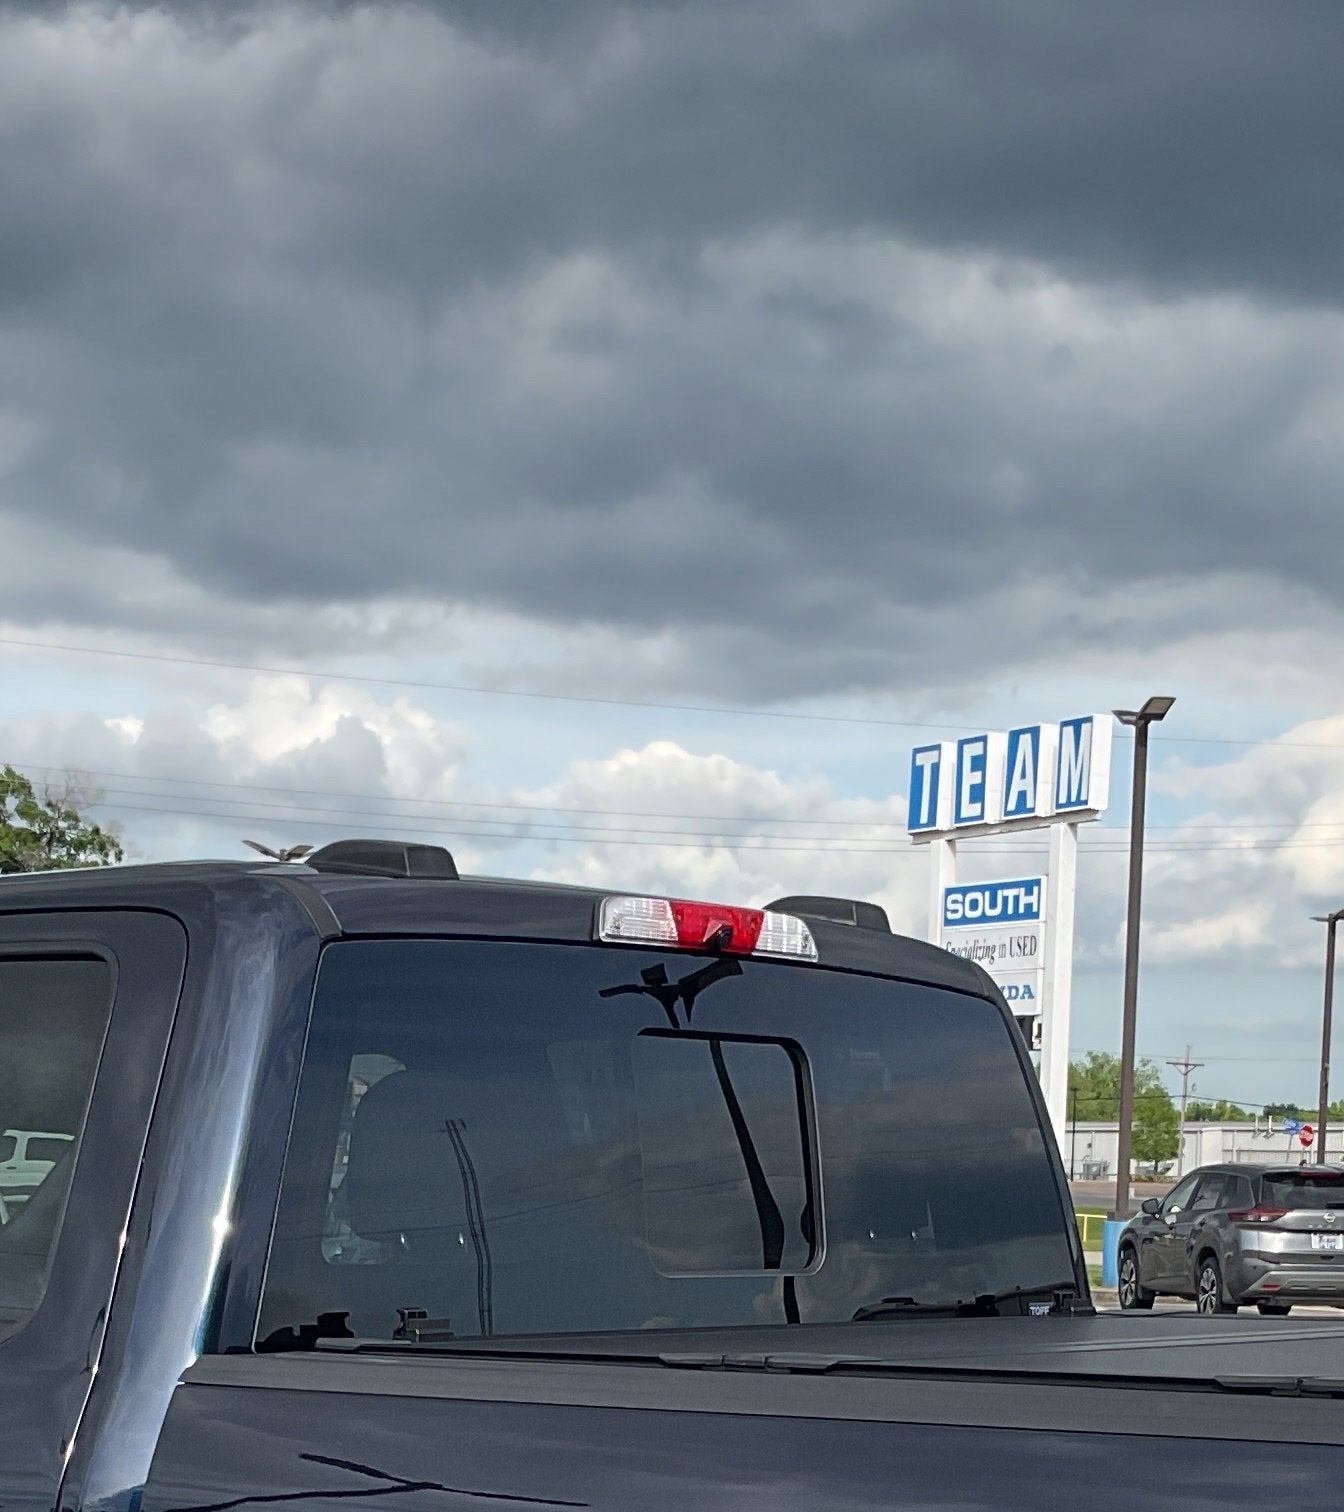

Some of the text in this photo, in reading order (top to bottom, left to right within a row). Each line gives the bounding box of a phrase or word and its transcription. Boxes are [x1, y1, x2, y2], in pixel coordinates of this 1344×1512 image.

[914, 721, 1093, 825] TEAM
[945, 884, 1040, 921] SOUTH
[998, 938, 1007, 958] in
[1008, 934, 1038, 958] USED
